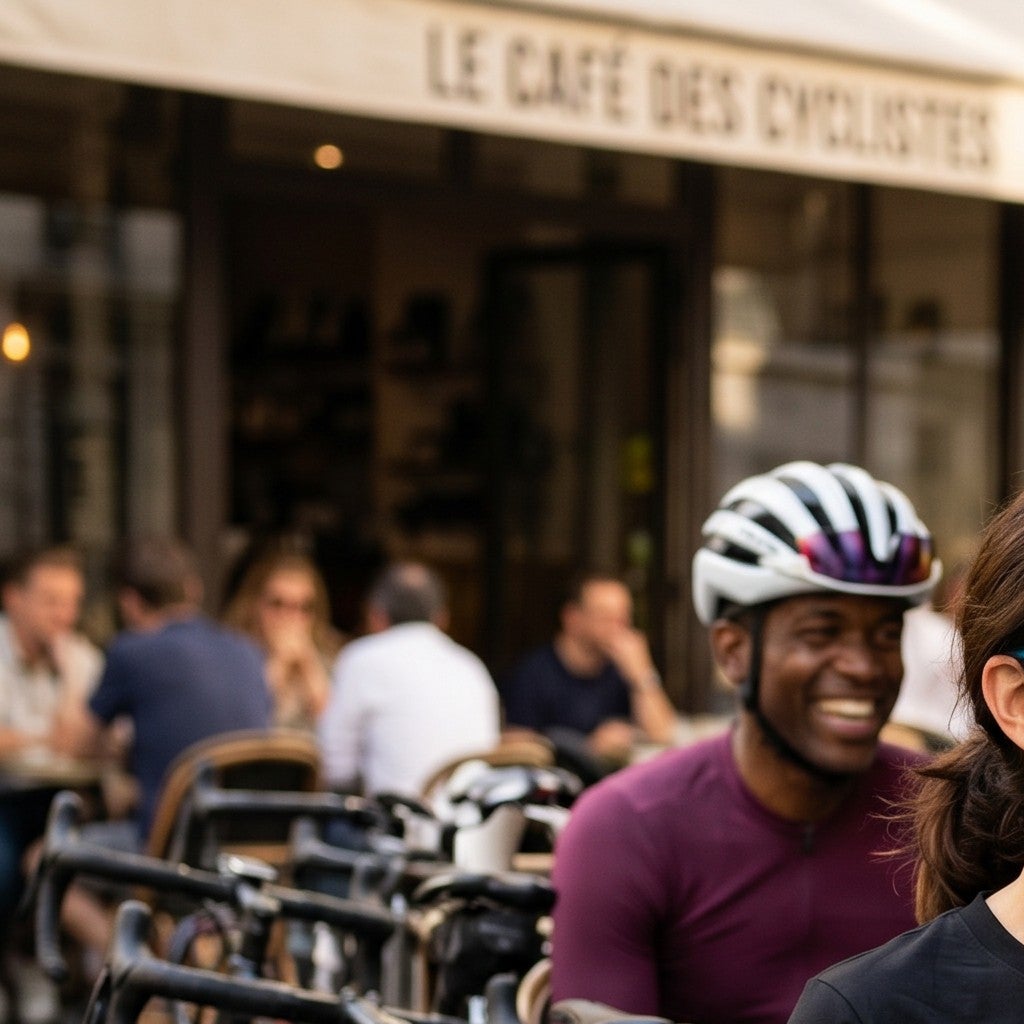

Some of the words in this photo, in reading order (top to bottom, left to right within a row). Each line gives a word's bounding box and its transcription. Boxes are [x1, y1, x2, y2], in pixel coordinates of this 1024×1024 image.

[424, 24, 485, 103] LE
[504, 32, 632, 126] CAFÉ
[647, 56, 743, 139] DES
[756, 69, 994, 171] CYCLISTES
